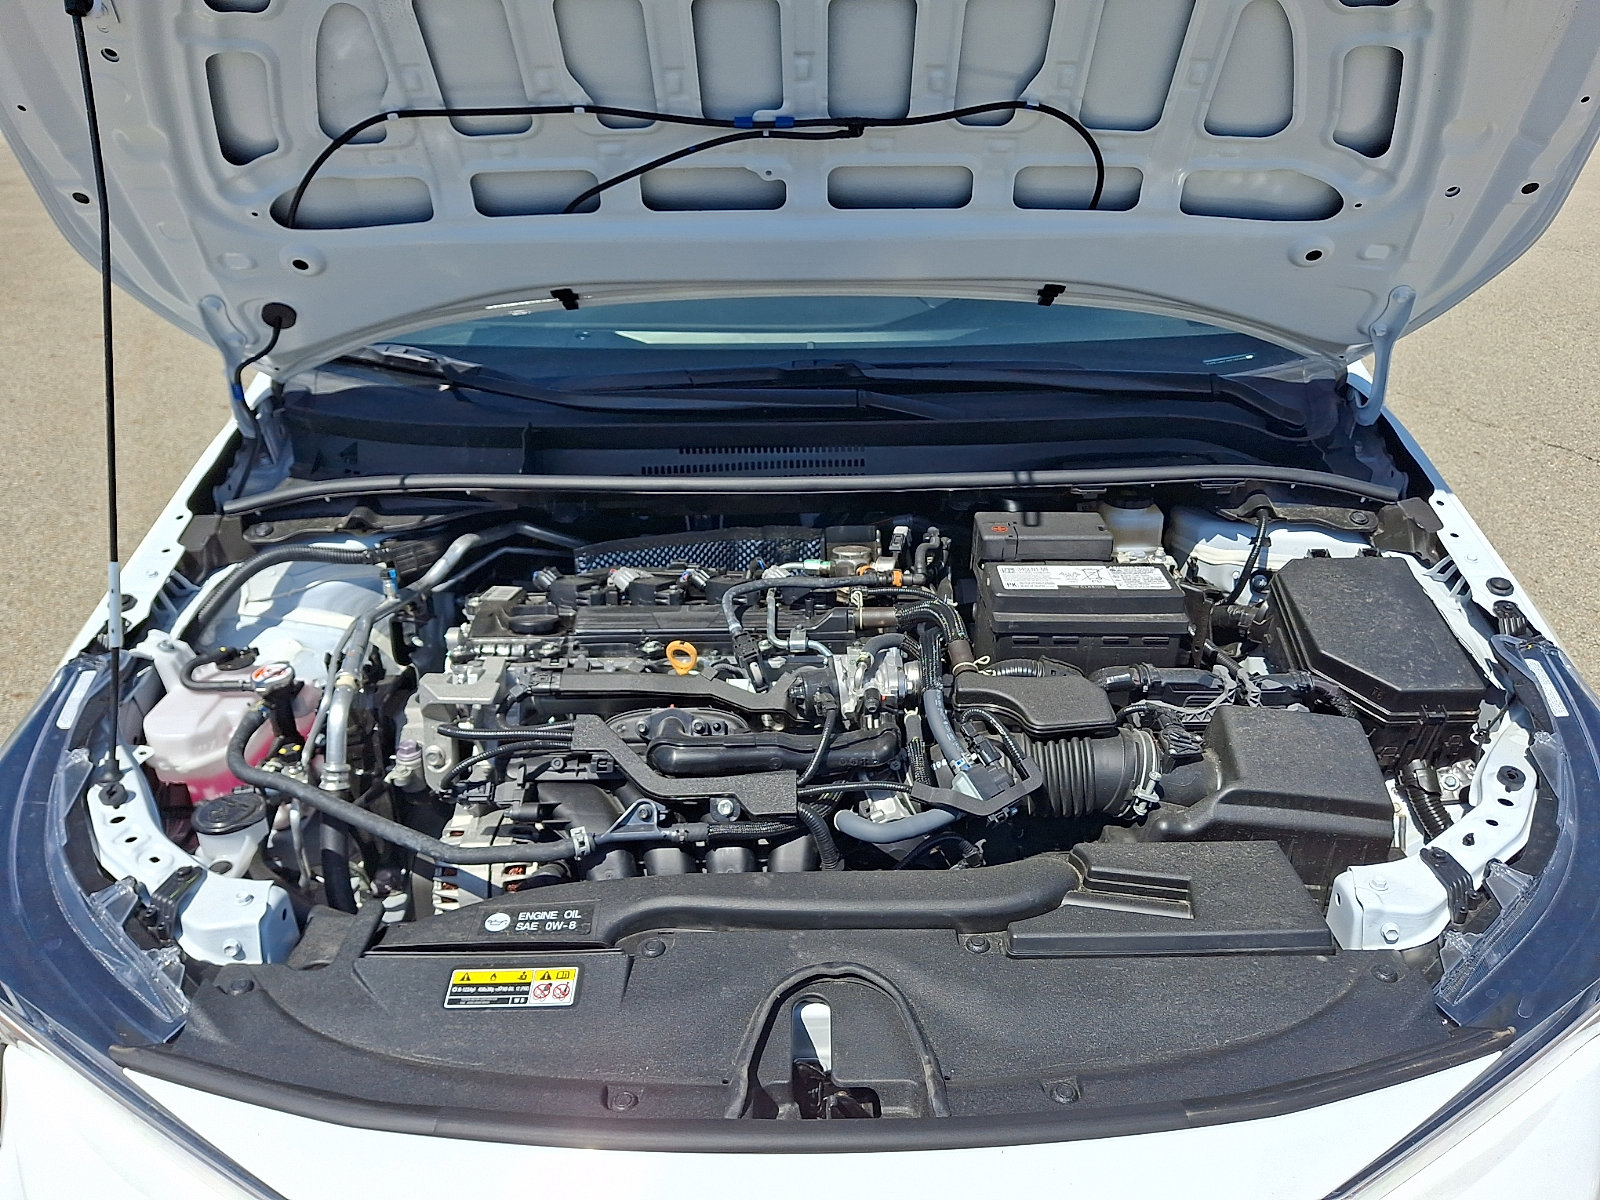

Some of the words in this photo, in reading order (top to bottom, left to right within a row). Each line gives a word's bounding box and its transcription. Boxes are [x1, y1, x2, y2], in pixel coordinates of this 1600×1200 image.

[518, 911, 559, 920] ENGINE
[563, 910, 582, 919] OIL
[515, 922, 540, 931] SAE
